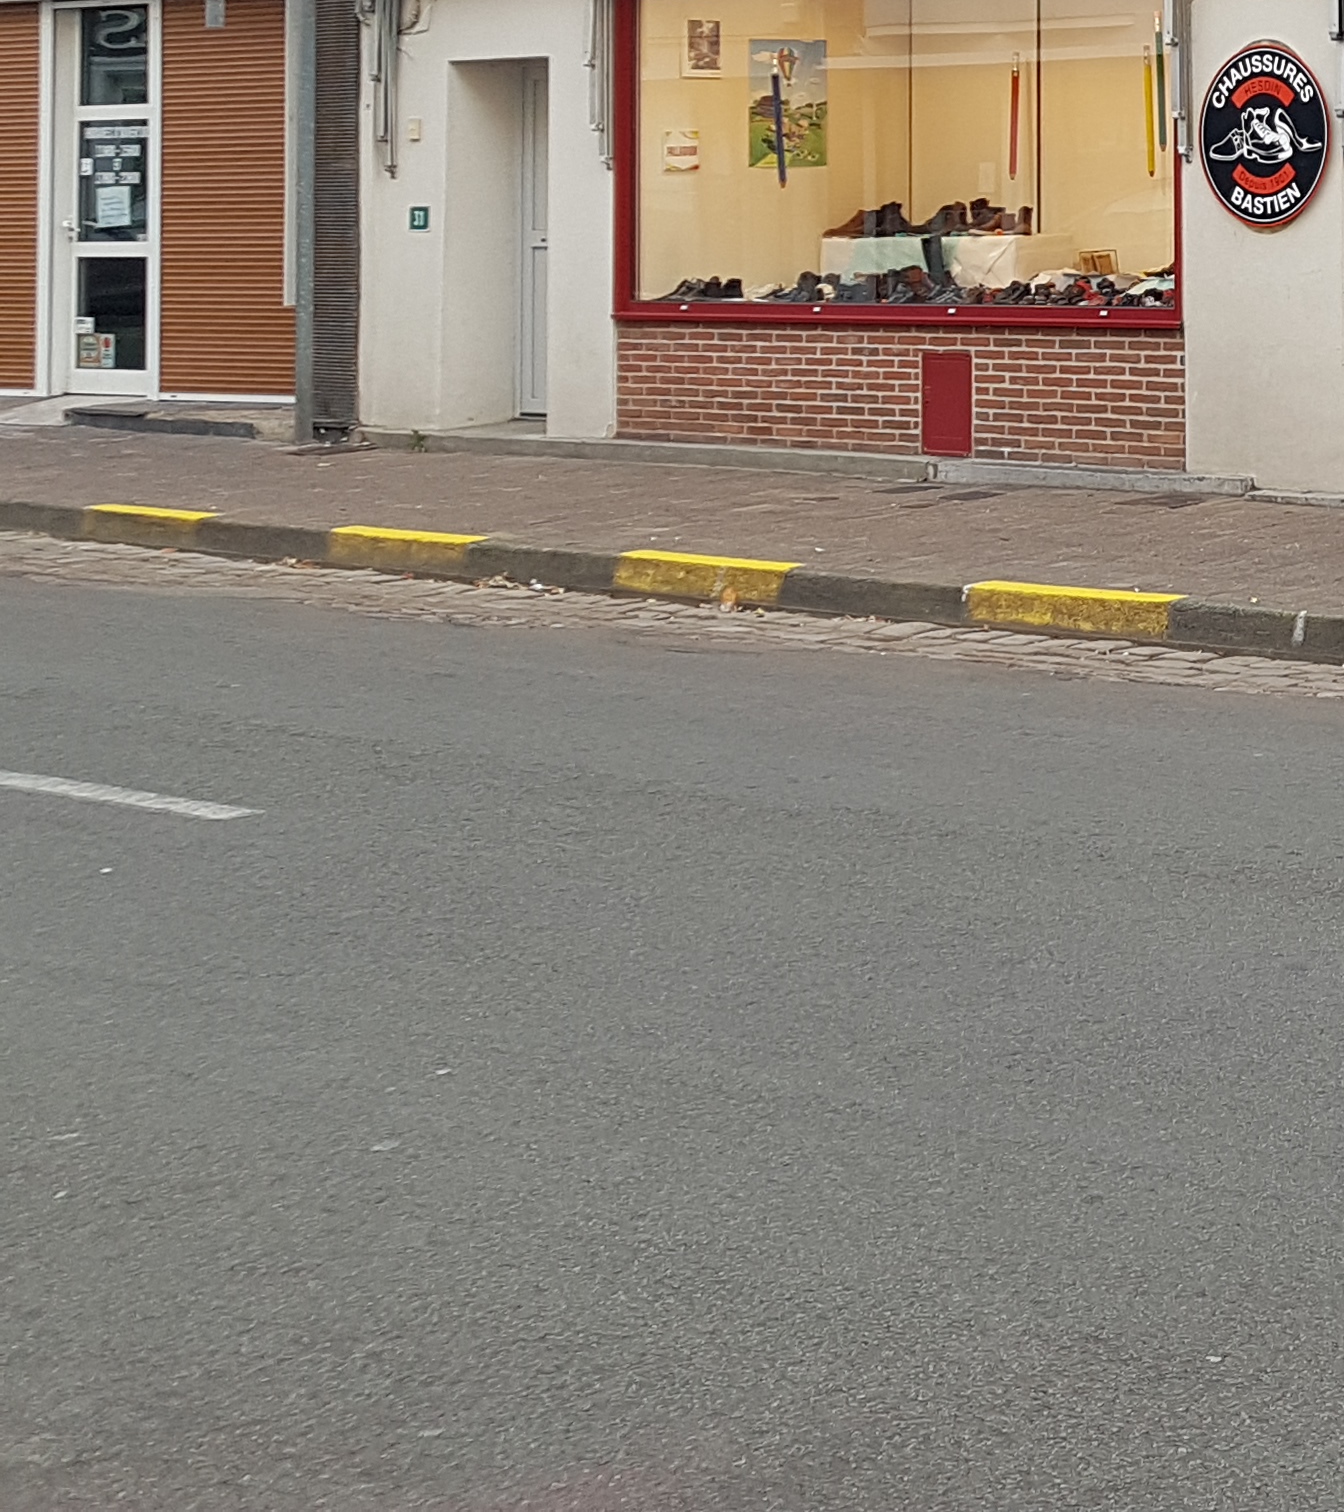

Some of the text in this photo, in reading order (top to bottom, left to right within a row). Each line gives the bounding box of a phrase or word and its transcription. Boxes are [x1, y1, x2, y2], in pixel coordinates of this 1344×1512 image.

[1212, 54, 1314, 109] CHAUSSURES
[1244, 79, 1282, 96] HESDIN
[1239, 170, 1267, 191] Depuis
[1231, 182, 1301, 214] BASTIEN
